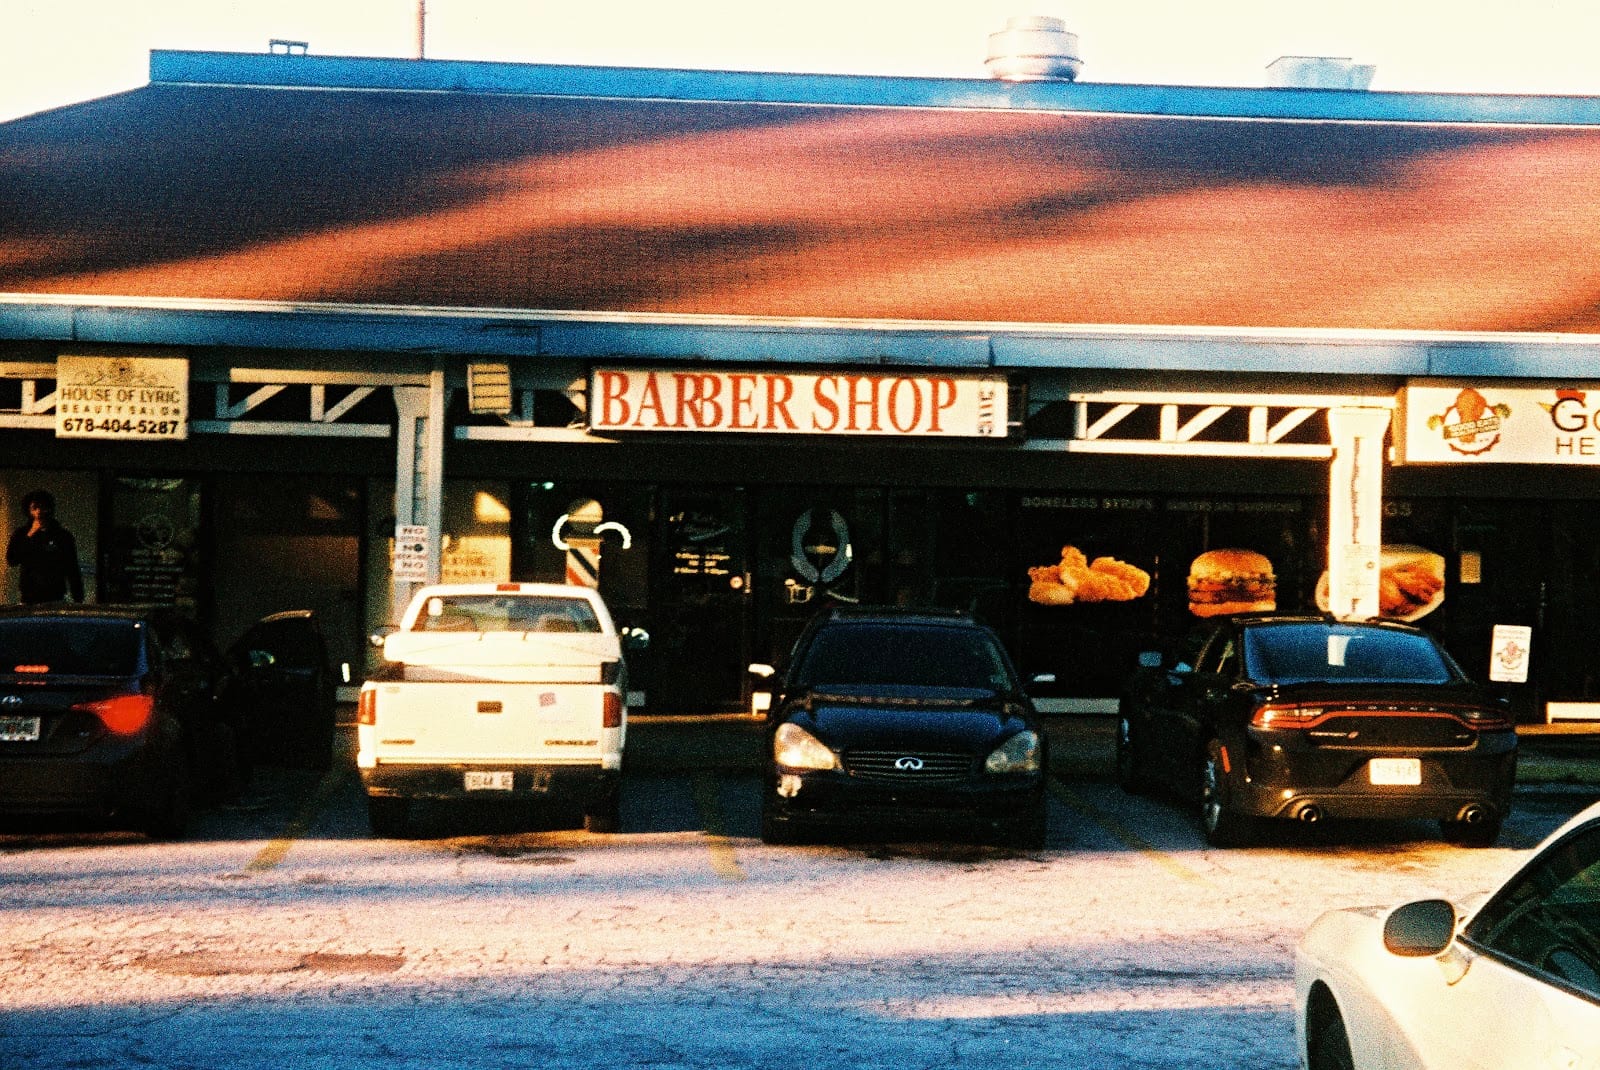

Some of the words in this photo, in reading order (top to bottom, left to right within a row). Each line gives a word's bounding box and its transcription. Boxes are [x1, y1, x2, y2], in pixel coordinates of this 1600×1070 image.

[61, 388, 112, 402] HOUSE
[117, 389, 136, 402] OF
[139, 390, 181, 404] LYRIC
[598, 371, 799, 430] BARBER
[812, 375, 957, 433] SHOP
[61, 404, 122, 414] BEAUTY
[63, 418, 179, 434] 678-404-5287
